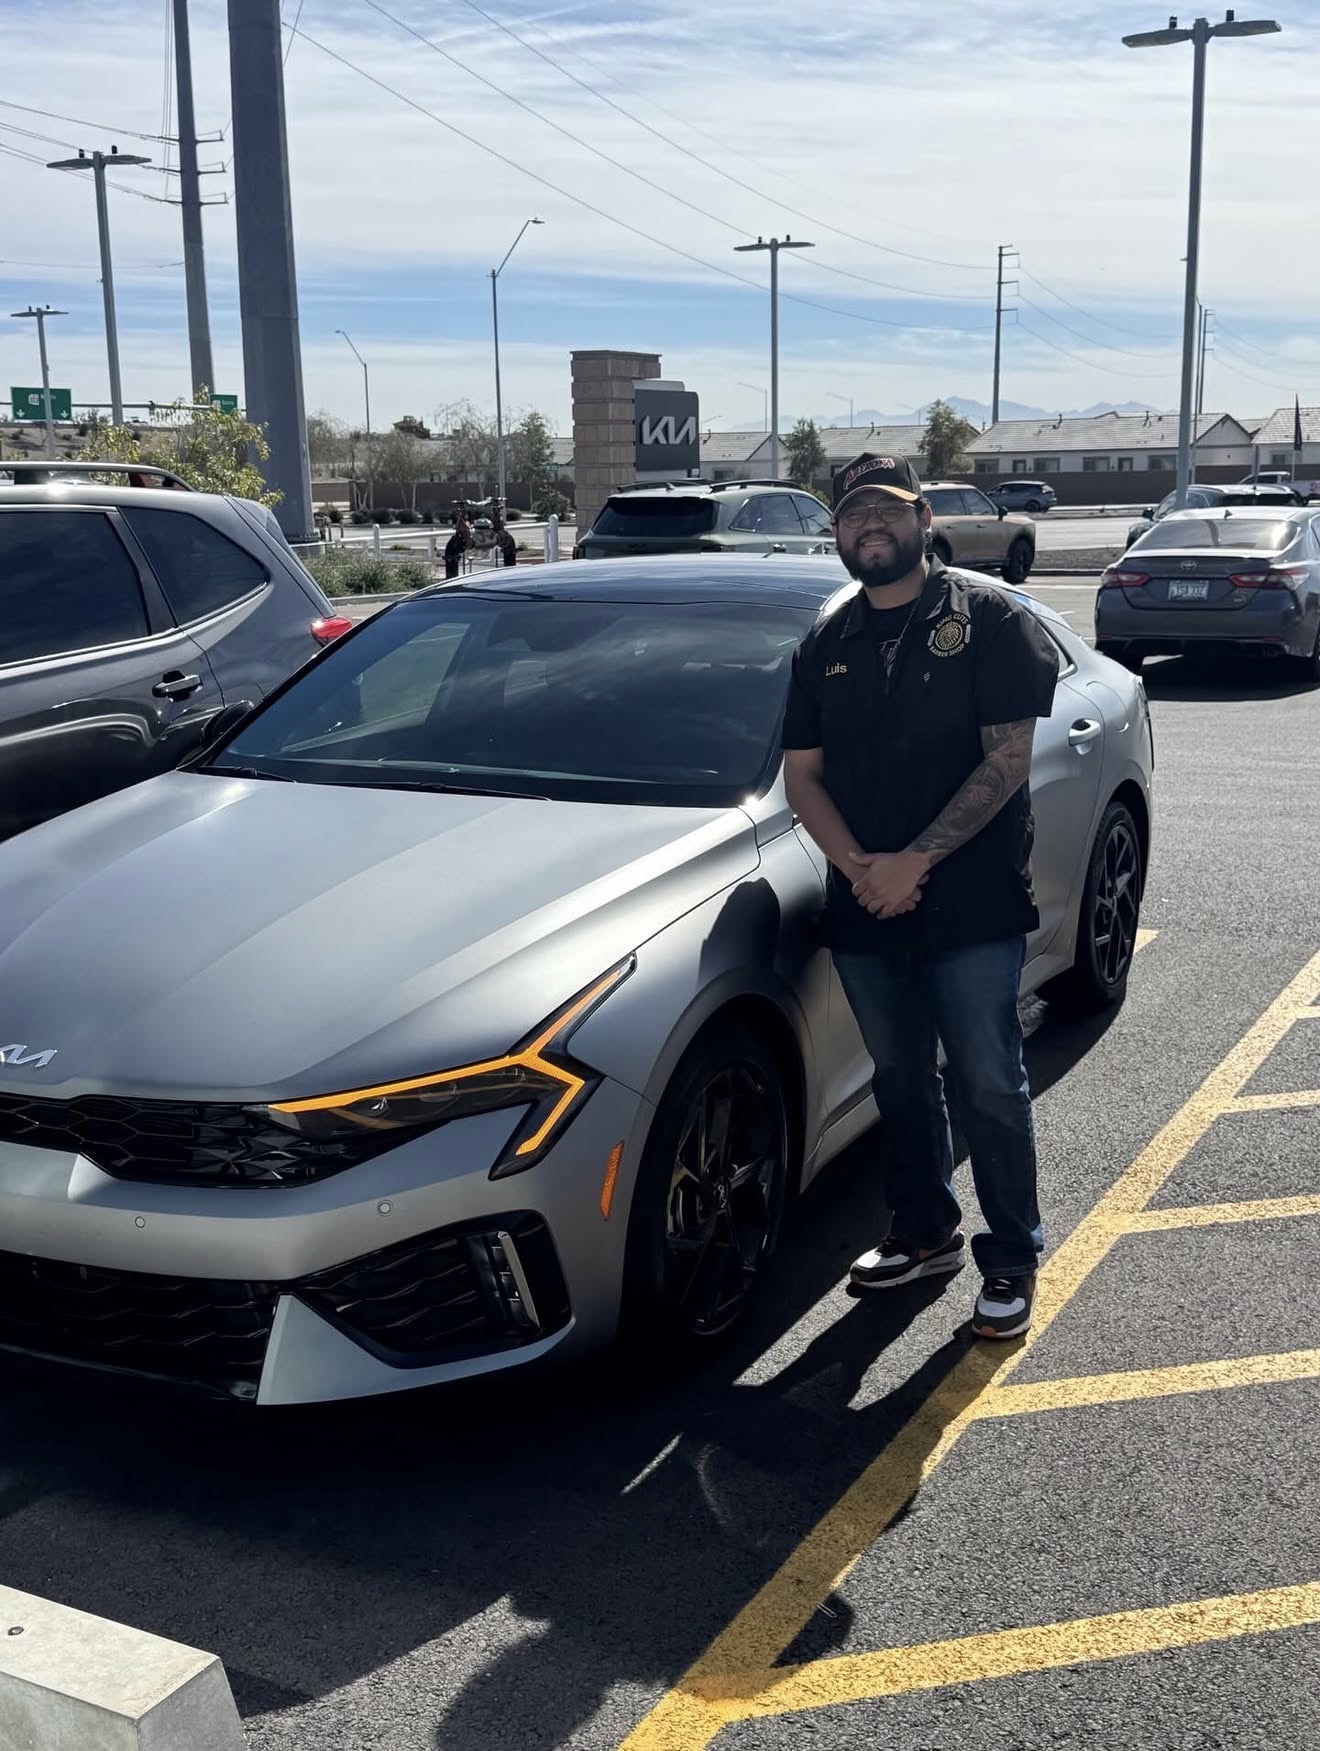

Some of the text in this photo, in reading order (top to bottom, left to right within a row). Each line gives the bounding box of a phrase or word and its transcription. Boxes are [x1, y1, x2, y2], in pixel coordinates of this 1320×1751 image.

[642, 416, 697, 445] KIA
[953, 613, 969, 625] CUTS
[948, 643, 965, 657] SHOP
[825, 662, 847, 677] Luis
